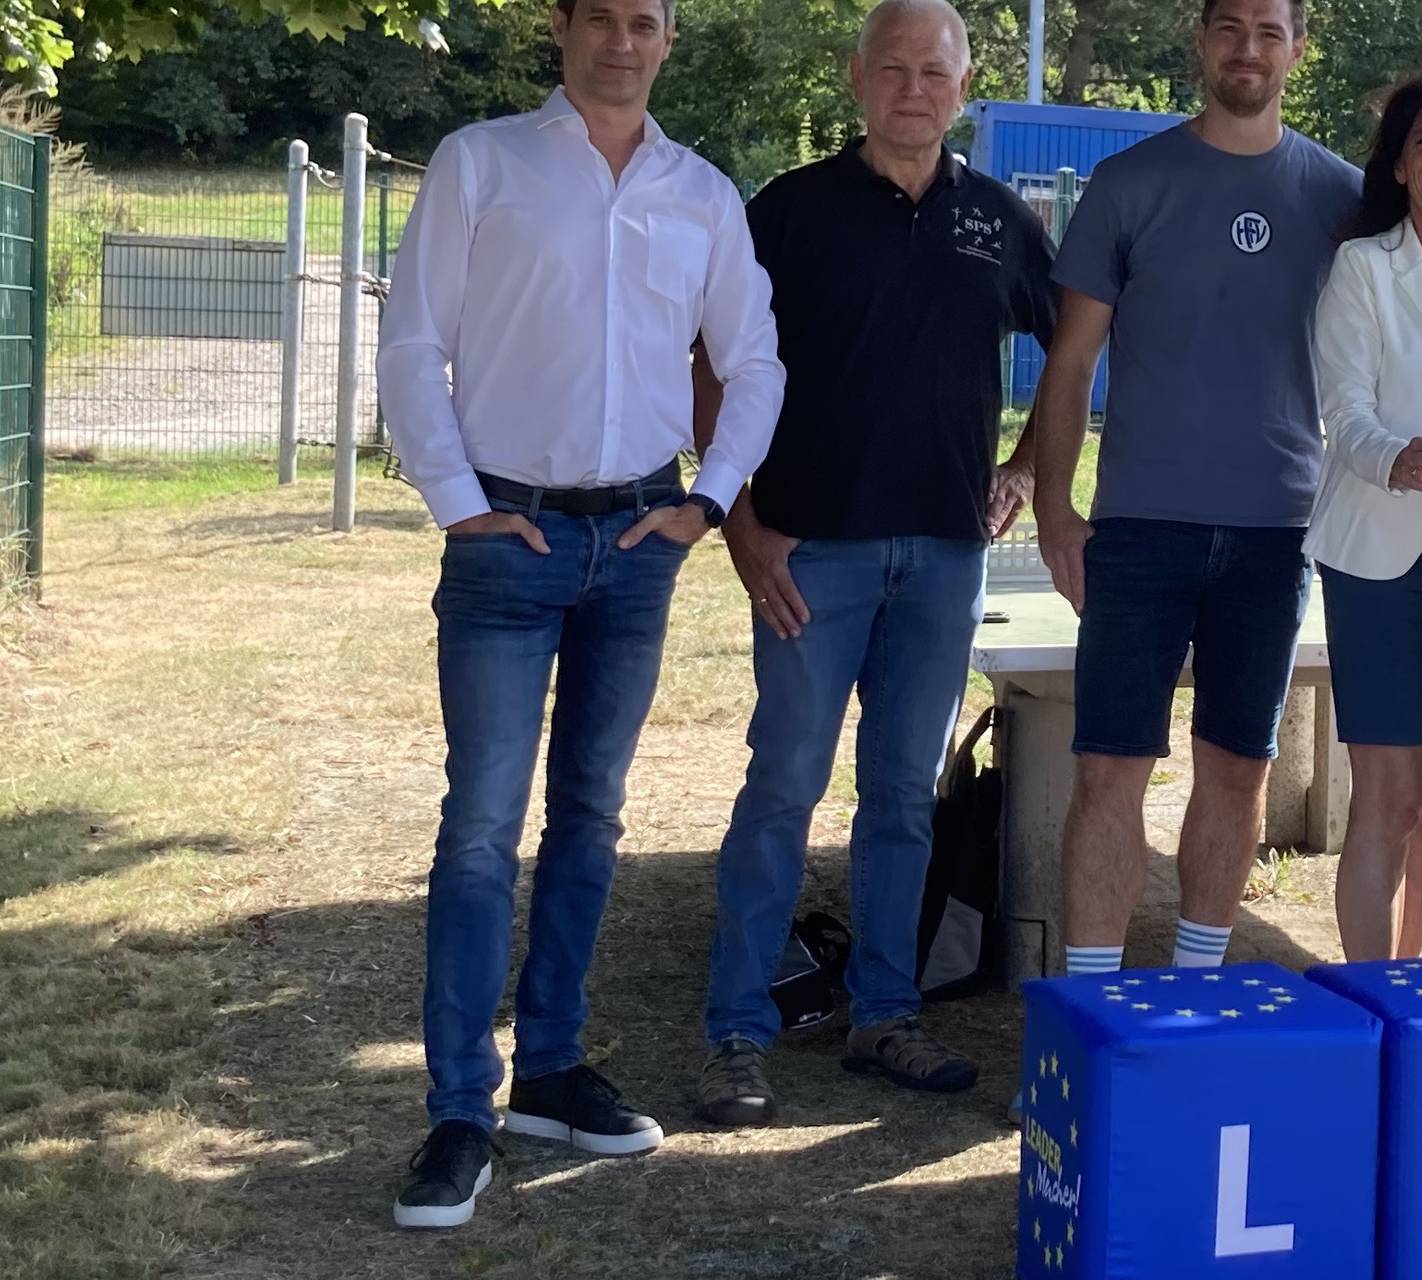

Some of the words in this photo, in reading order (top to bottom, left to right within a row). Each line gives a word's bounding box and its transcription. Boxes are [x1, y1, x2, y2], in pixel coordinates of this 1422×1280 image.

[964, 218, 993, 236] SPS
[1025, 1113, 1062, 1174] LEADER
[1035, 1161, 1082, 1217] Macher!
